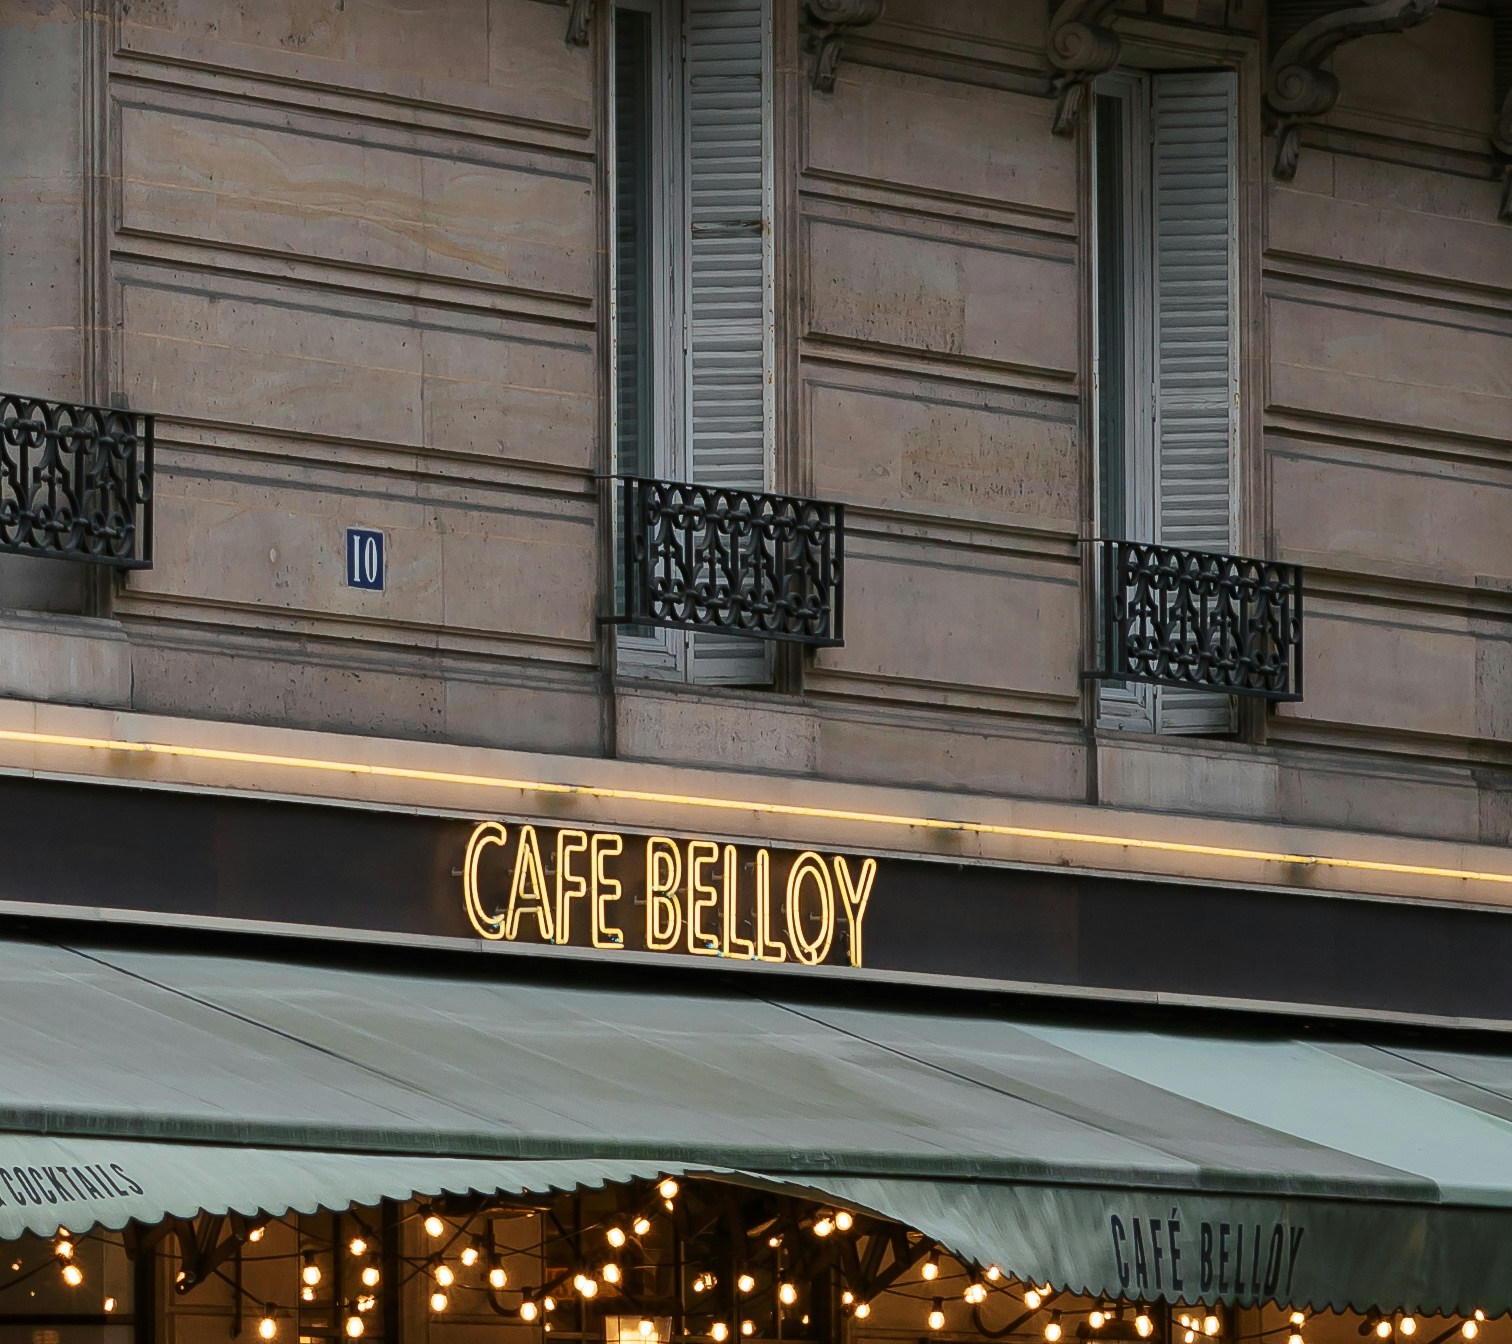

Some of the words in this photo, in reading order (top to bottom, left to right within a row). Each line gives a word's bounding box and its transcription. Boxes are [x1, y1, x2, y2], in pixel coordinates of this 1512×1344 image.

[353, 535, 378, 583] 10
[463, 821, 624, 950] CAFE
[645, 836, 877, 968] BELLOY
[1110, 1207, 1183, 1292] CAFÉ
[1200, 1222, 1304, 1296] BELLOY
